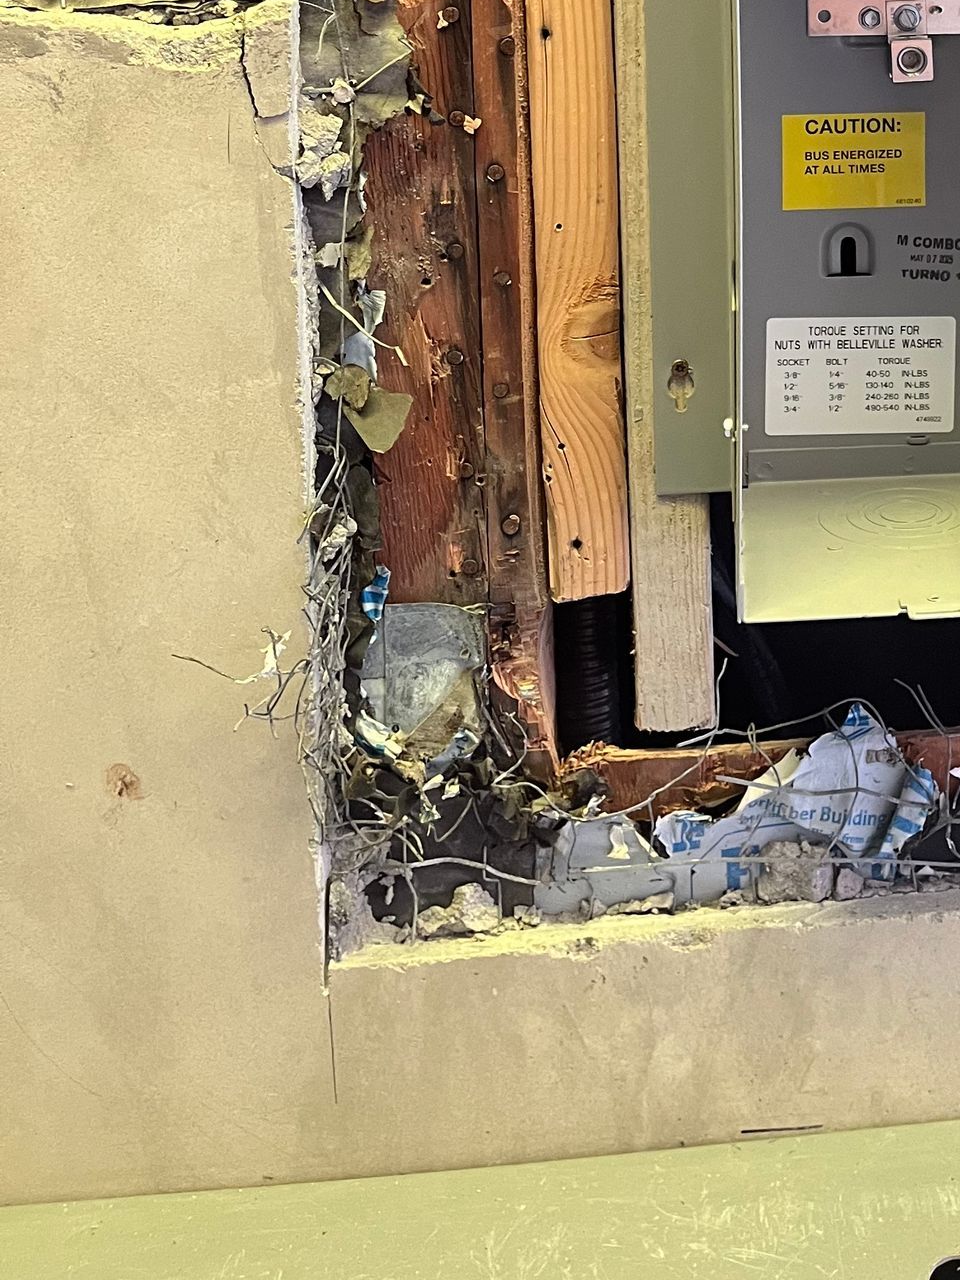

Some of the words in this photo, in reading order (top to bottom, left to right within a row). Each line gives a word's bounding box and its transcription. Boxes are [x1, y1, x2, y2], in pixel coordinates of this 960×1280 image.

[805, 117, 901, 135] CAUTION:
[804, 151, 829, 160] BUS
[833, 149, 902, 160] ENERGIZED
[804, 165, 819, 175] AT
[822, 165, 845, 174] ALL
[848, 164, 885, 173] TIMES
[897, 234, 908, 246] M
[910, 254, 924, 262] MAY
[901, 269, 951, 282] TURNO
[808, 326, 846, 336] TORQUE
[853, 325, 894, 335] SETTING
[900, 325, 920, 335] FOR
[774, 340, 801, 350] NUTS
[807, 340, 831, 350] WITH
[837, 339, 896, 349] BELLEVILLE
[826, 358, 848, 366] BOLT
[866, 370, 890, 378] 40-50
